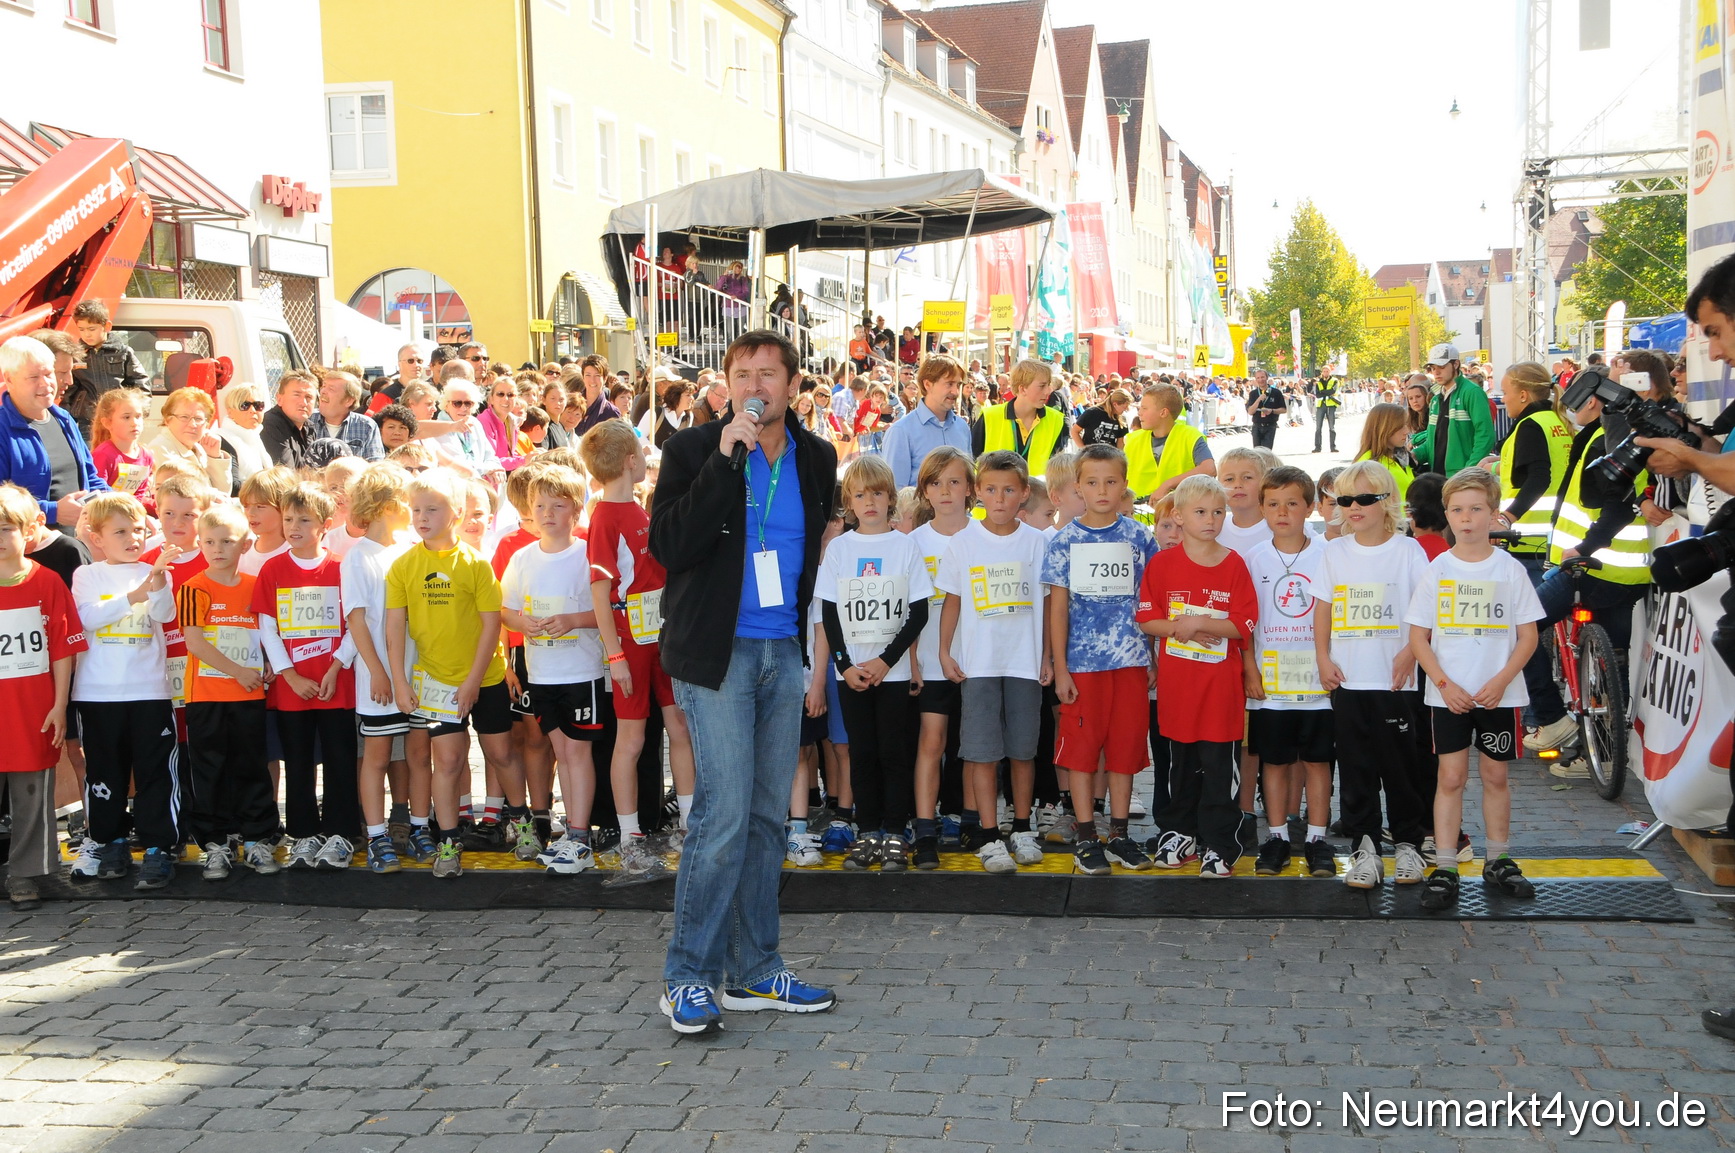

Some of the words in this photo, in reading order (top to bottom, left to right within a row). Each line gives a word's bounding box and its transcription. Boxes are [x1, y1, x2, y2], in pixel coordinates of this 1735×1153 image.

[1367, 305, 1410, 313] Schnupper-
[1196, 352, 1206, 363] A
[987, 567, 1015, 578] Moritz
[1089, 563, 1130, 578] 7305
[848, 578, 895, 600] Ben
[990, 581, 1030, 599] 7076
[1349, 588, 1374, 599] Tizian
[1458, 584, 1483, 596] Kilian
[294, 591, 322, 601] Florian
[533, 600, 550, 610] Elias
[844, 598, 903, 622] 10214
[1440, 600, 1450, 609] K4
[1458, 602, 1504, 618] 7116
[295, 606, 335, 621] 7045
[631, 613, 639, 621] K4
[1350, 604, 1394, 620] 7084
[210, 615, 255, 624] SportScheck
[220, 646, 259, 661] 7004
[303, 645, 322, 656] DEHN
[1280, 655, 1312, 665] Joshua
[575, 708, 591, 721] 13
[1480, 731, 1512, 753] 20
